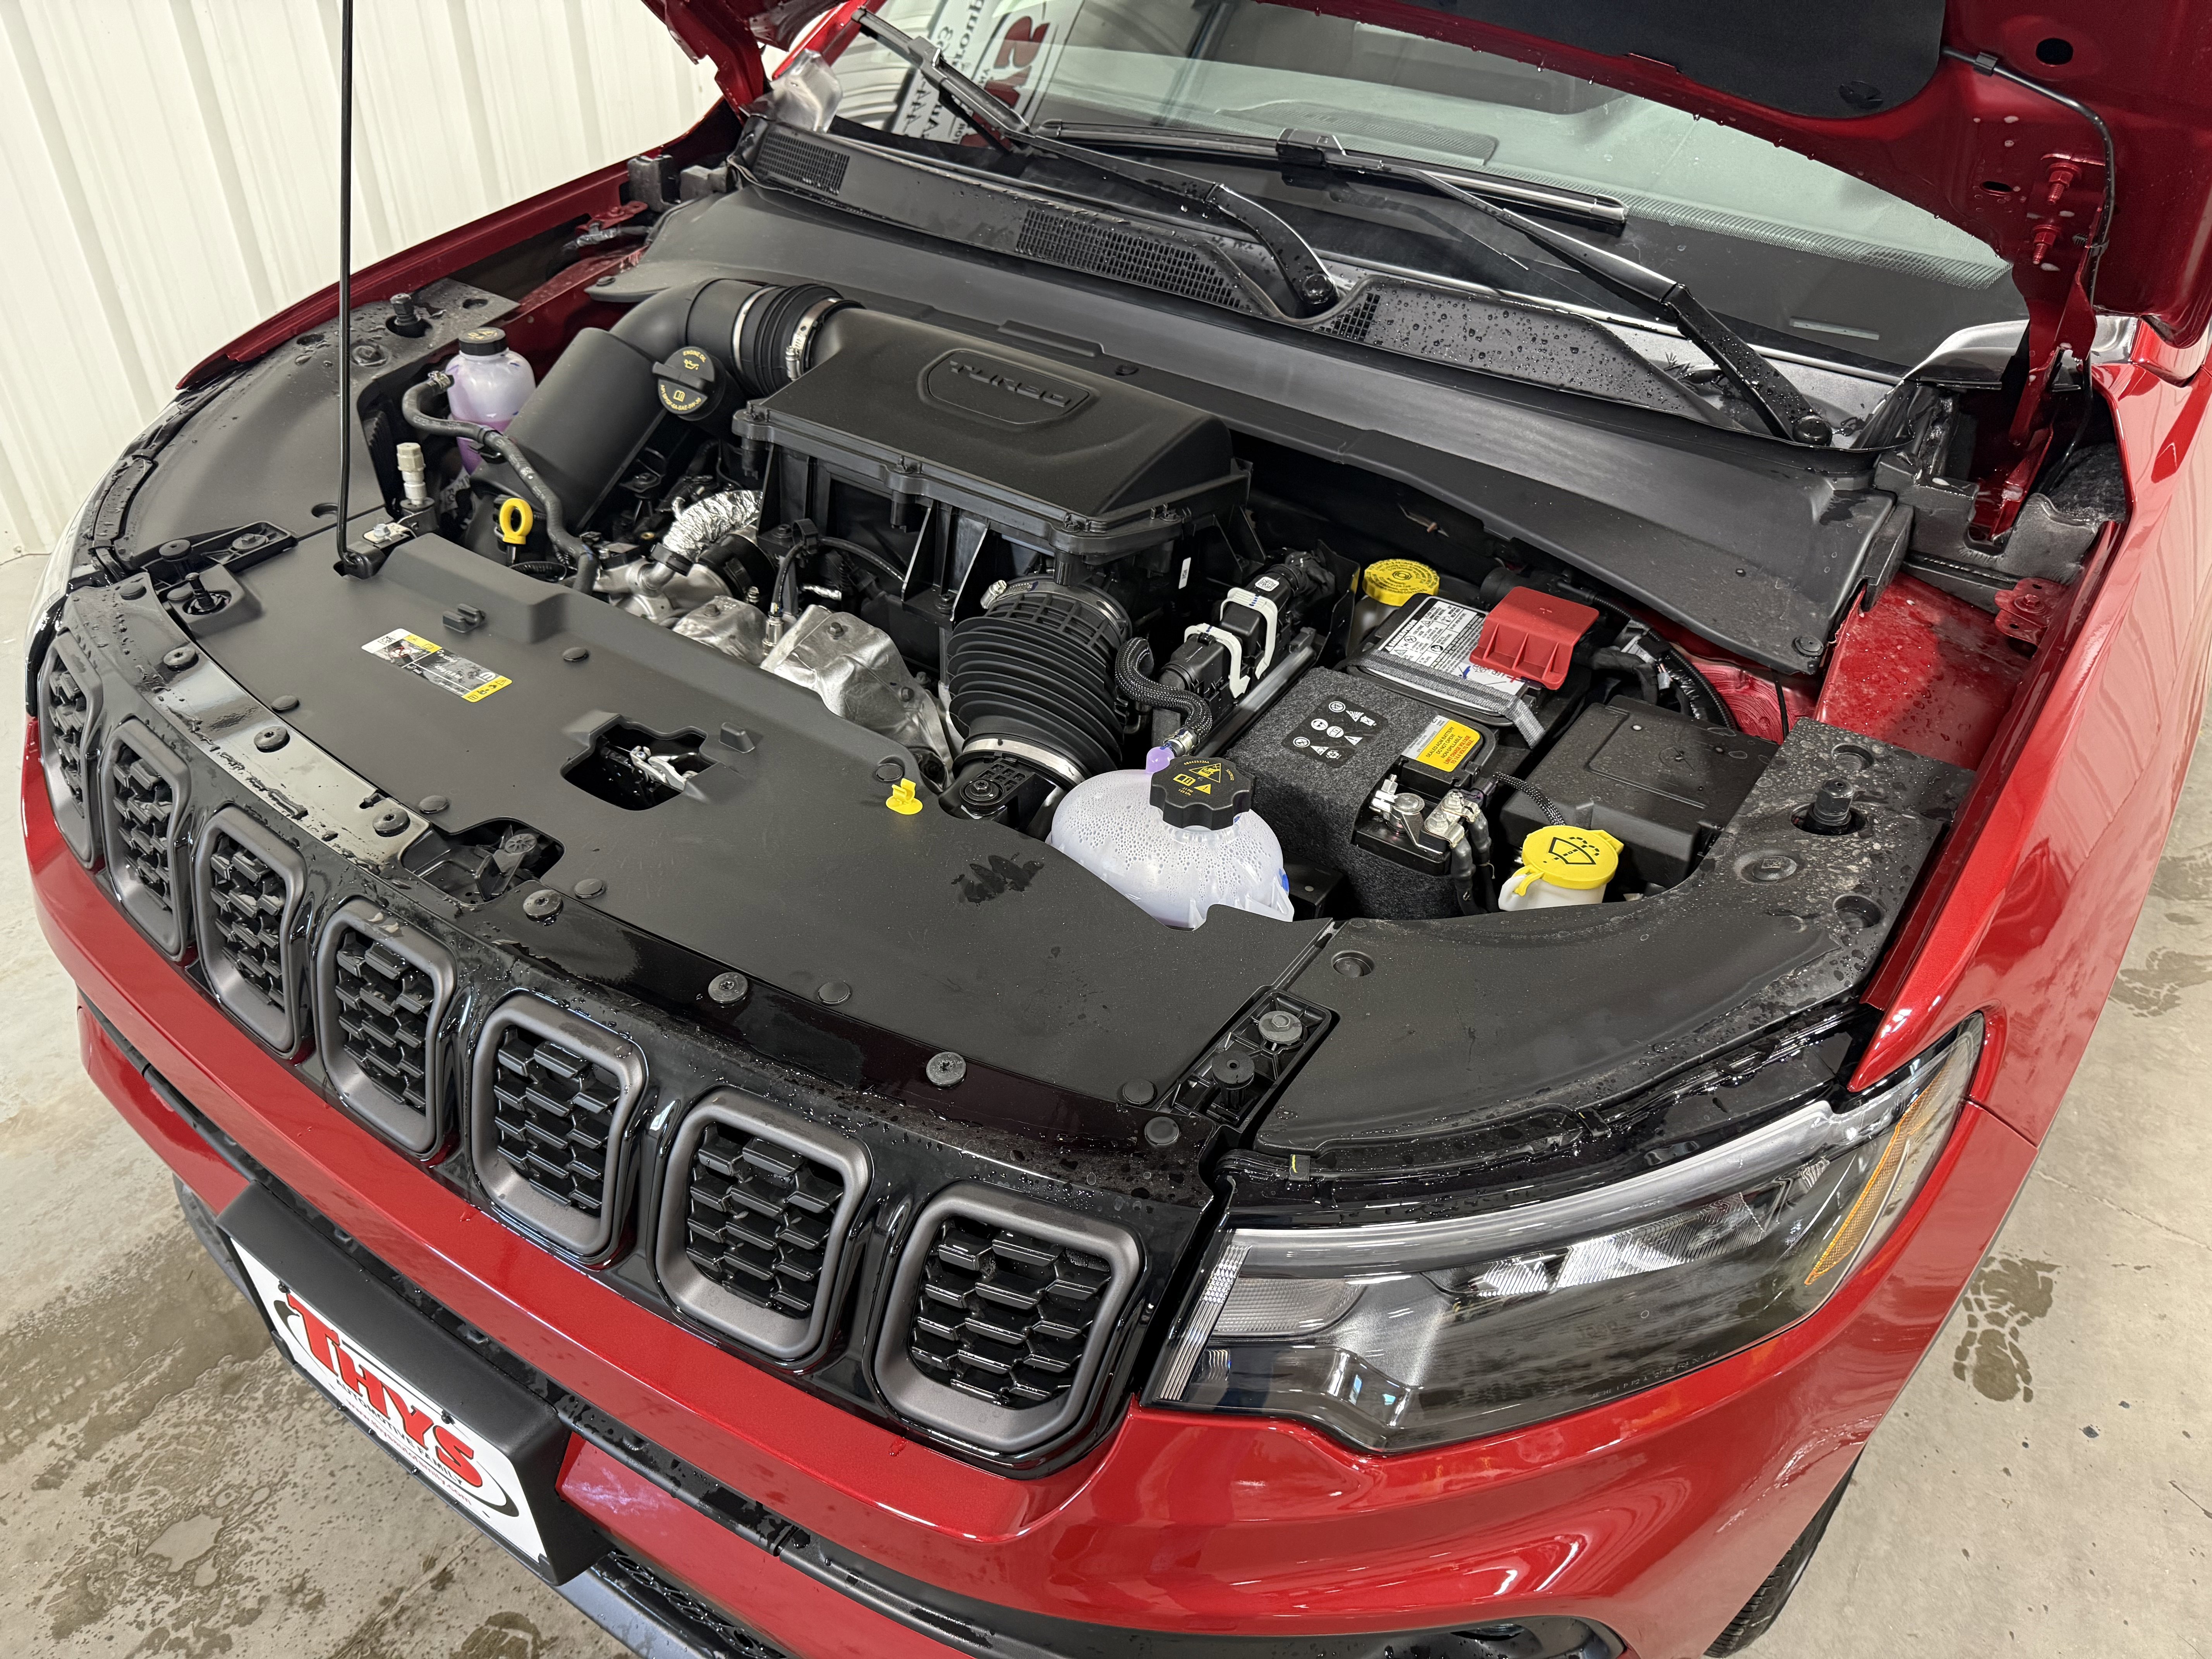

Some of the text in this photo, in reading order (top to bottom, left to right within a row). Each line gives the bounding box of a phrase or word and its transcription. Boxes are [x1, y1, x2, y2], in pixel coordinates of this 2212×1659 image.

[949, 360, 1072, 408] TURBO
[1425, 745, 1438, 757] SEALED
[1441, 726, 1455, 740] BATTERY
[1440, 735, 1463, 758] NON-SPILLABLE
[287, 1292, 483, 1488] THYS
[336, 1378, 462, 1486] AUTOMOTIVE FAMILY
